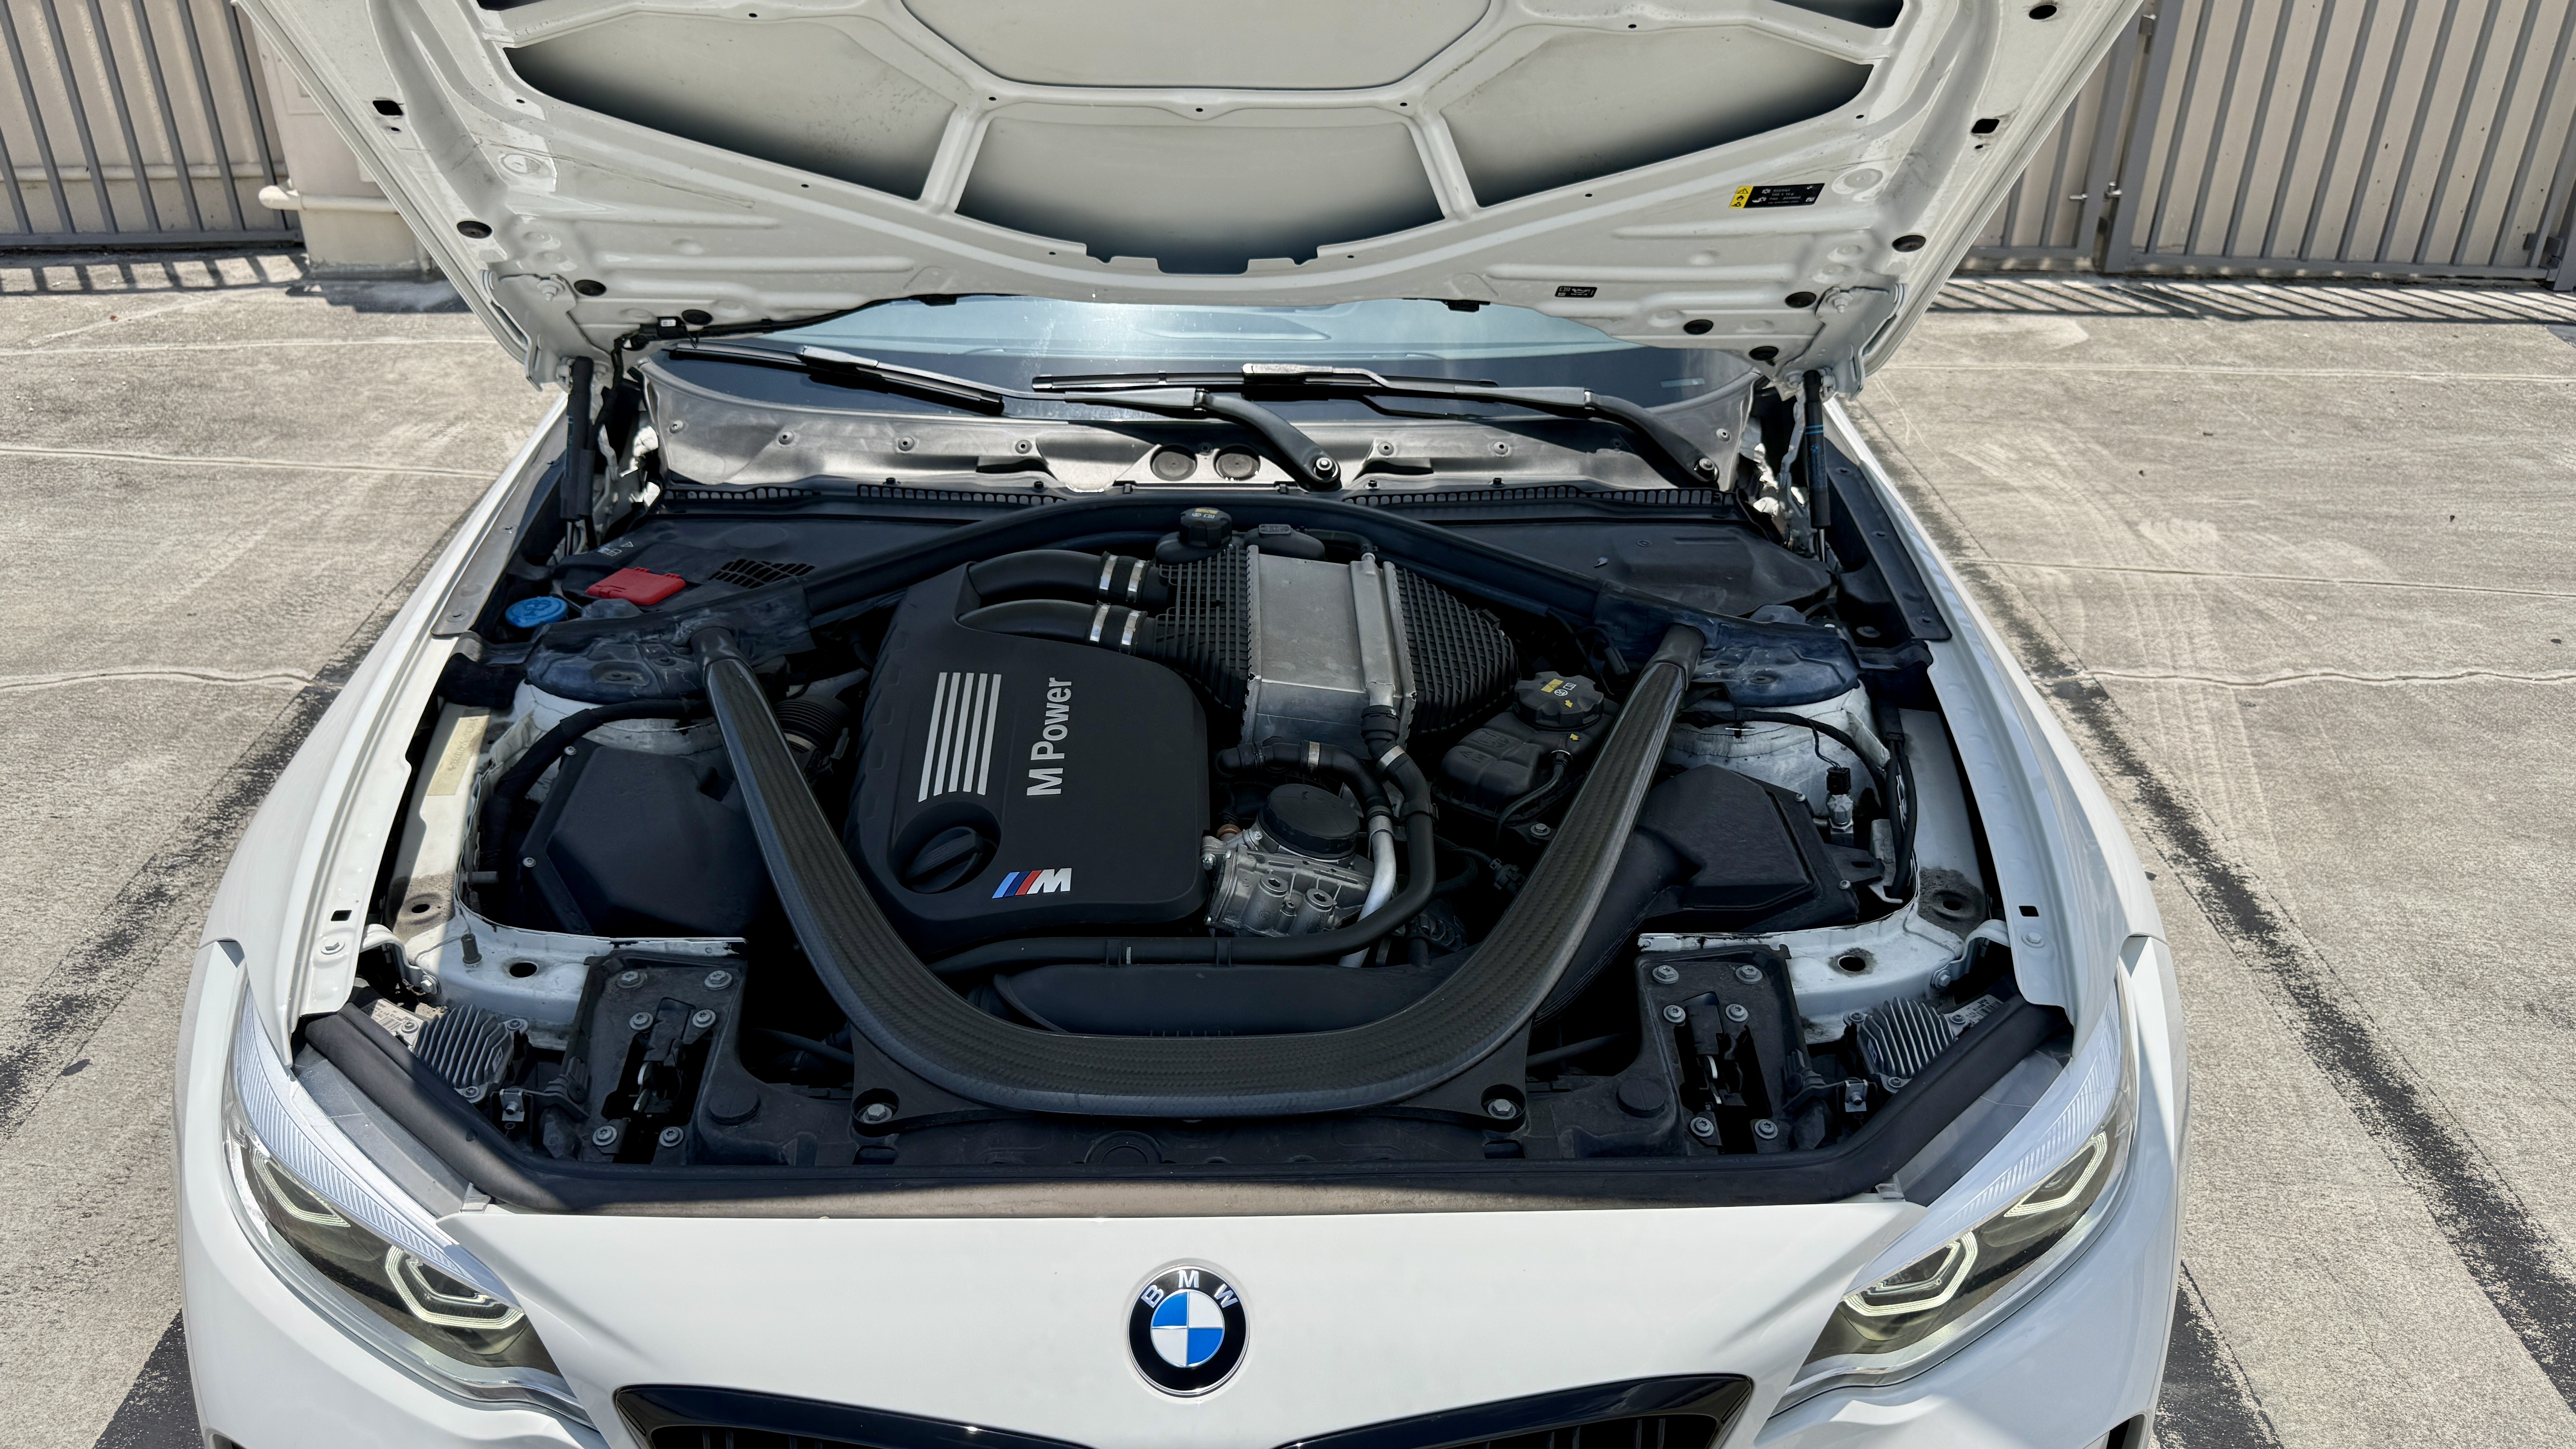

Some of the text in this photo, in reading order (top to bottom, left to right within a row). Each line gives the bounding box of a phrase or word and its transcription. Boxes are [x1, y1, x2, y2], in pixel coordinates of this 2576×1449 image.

[1026, 677, 1072, 796] M Power
[1141, 1270, 1238, 1308] BMW
